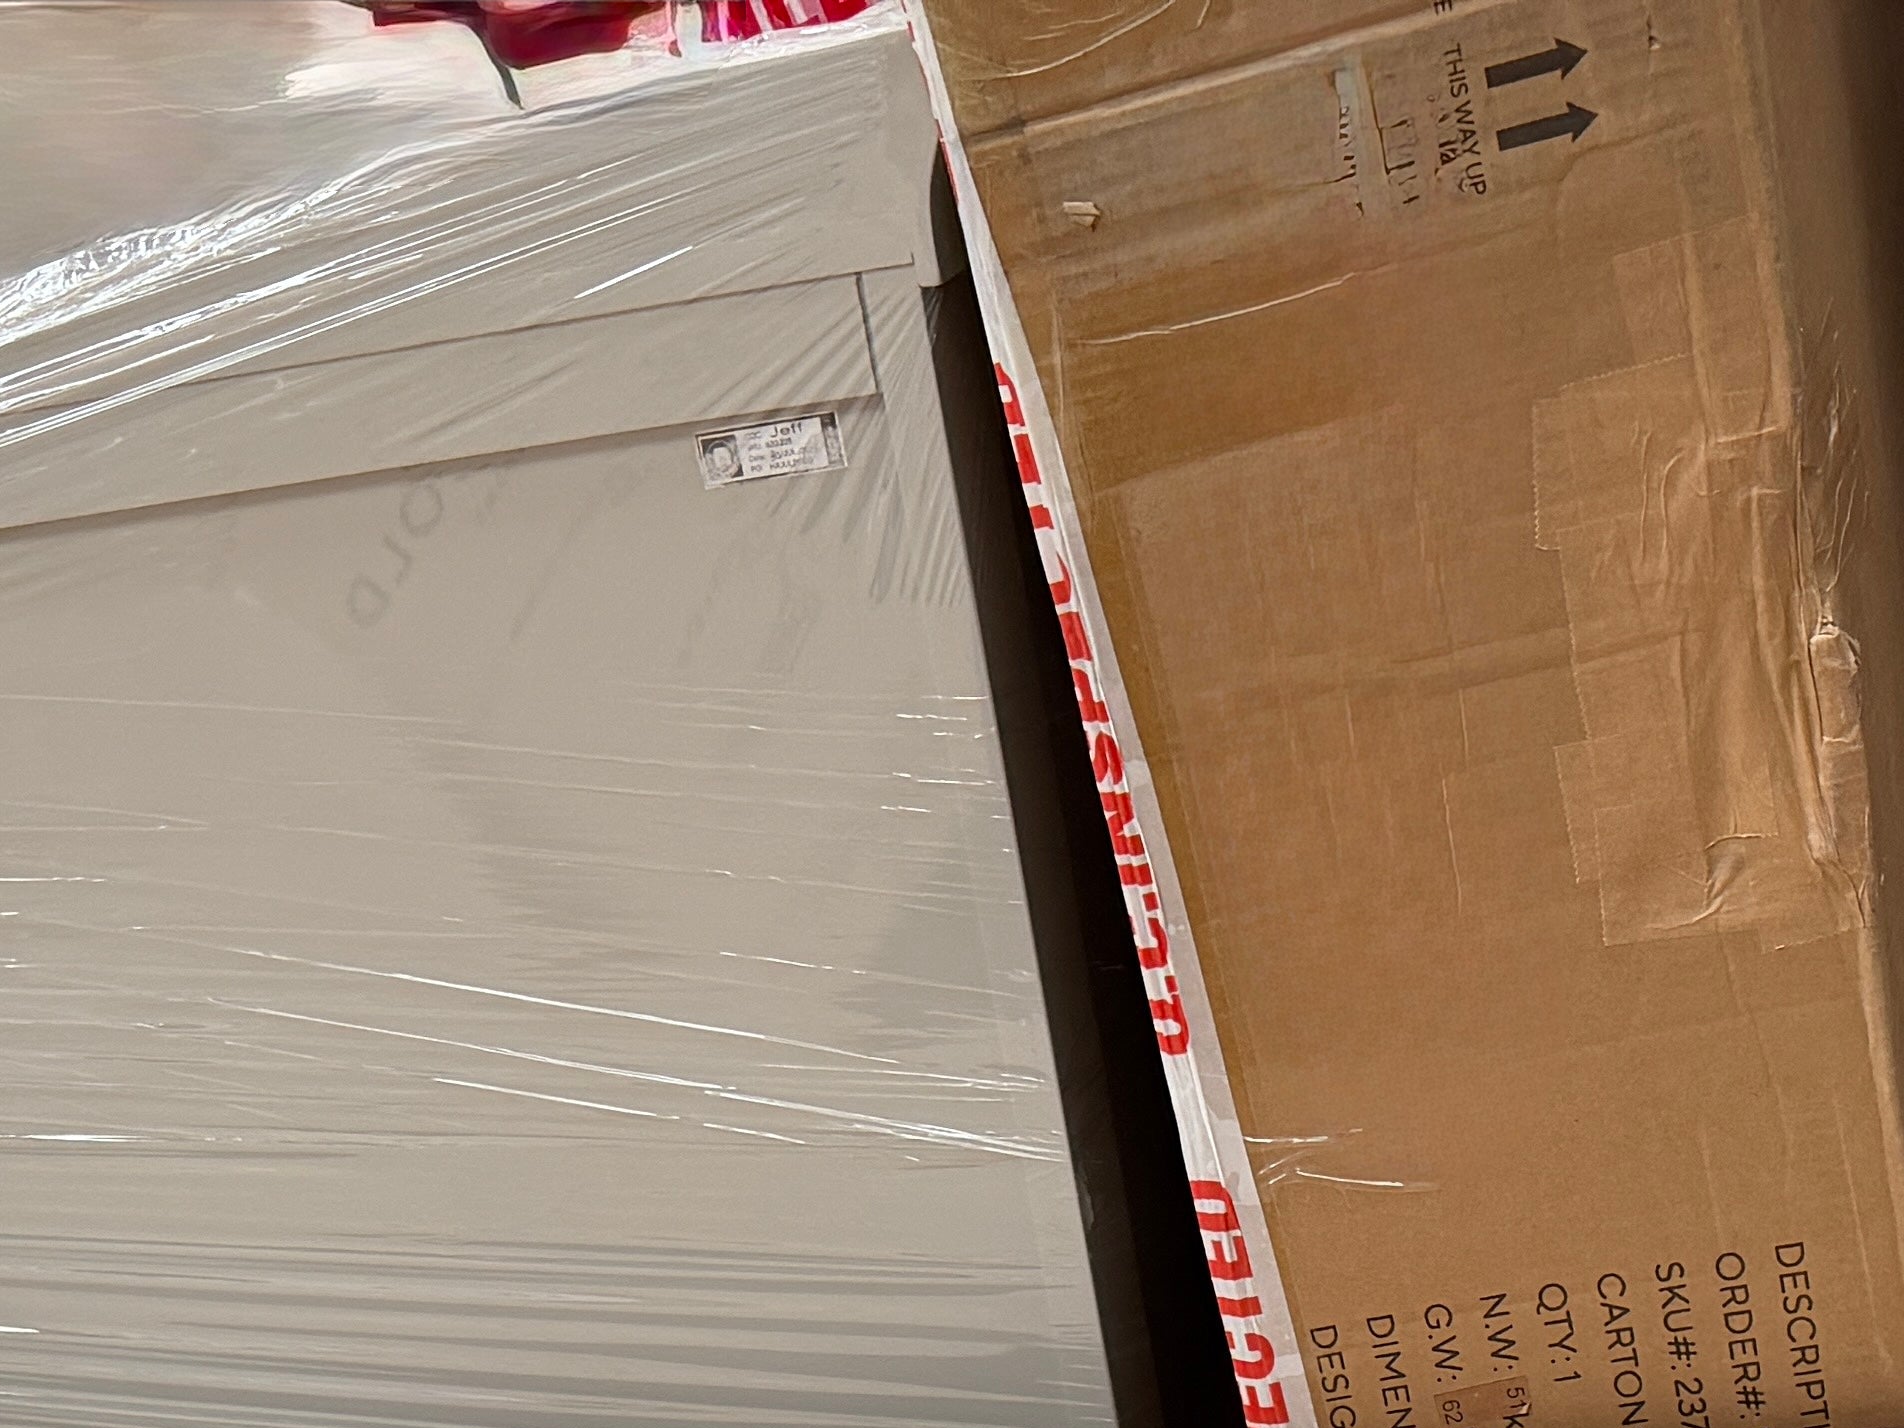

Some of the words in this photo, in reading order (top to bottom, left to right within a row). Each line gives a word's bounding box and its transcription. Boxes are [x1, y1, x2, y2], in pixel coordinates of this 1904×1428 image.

[1443, 42, 1469, 98] THIS
[1454, 100, 1481, 156] WAY
[1465, 161, 1487, 195] UP
[994, 362, 1189, 1055] Q.C.INSP
[1715, 1252, 1766, 1419] ORDER#:
